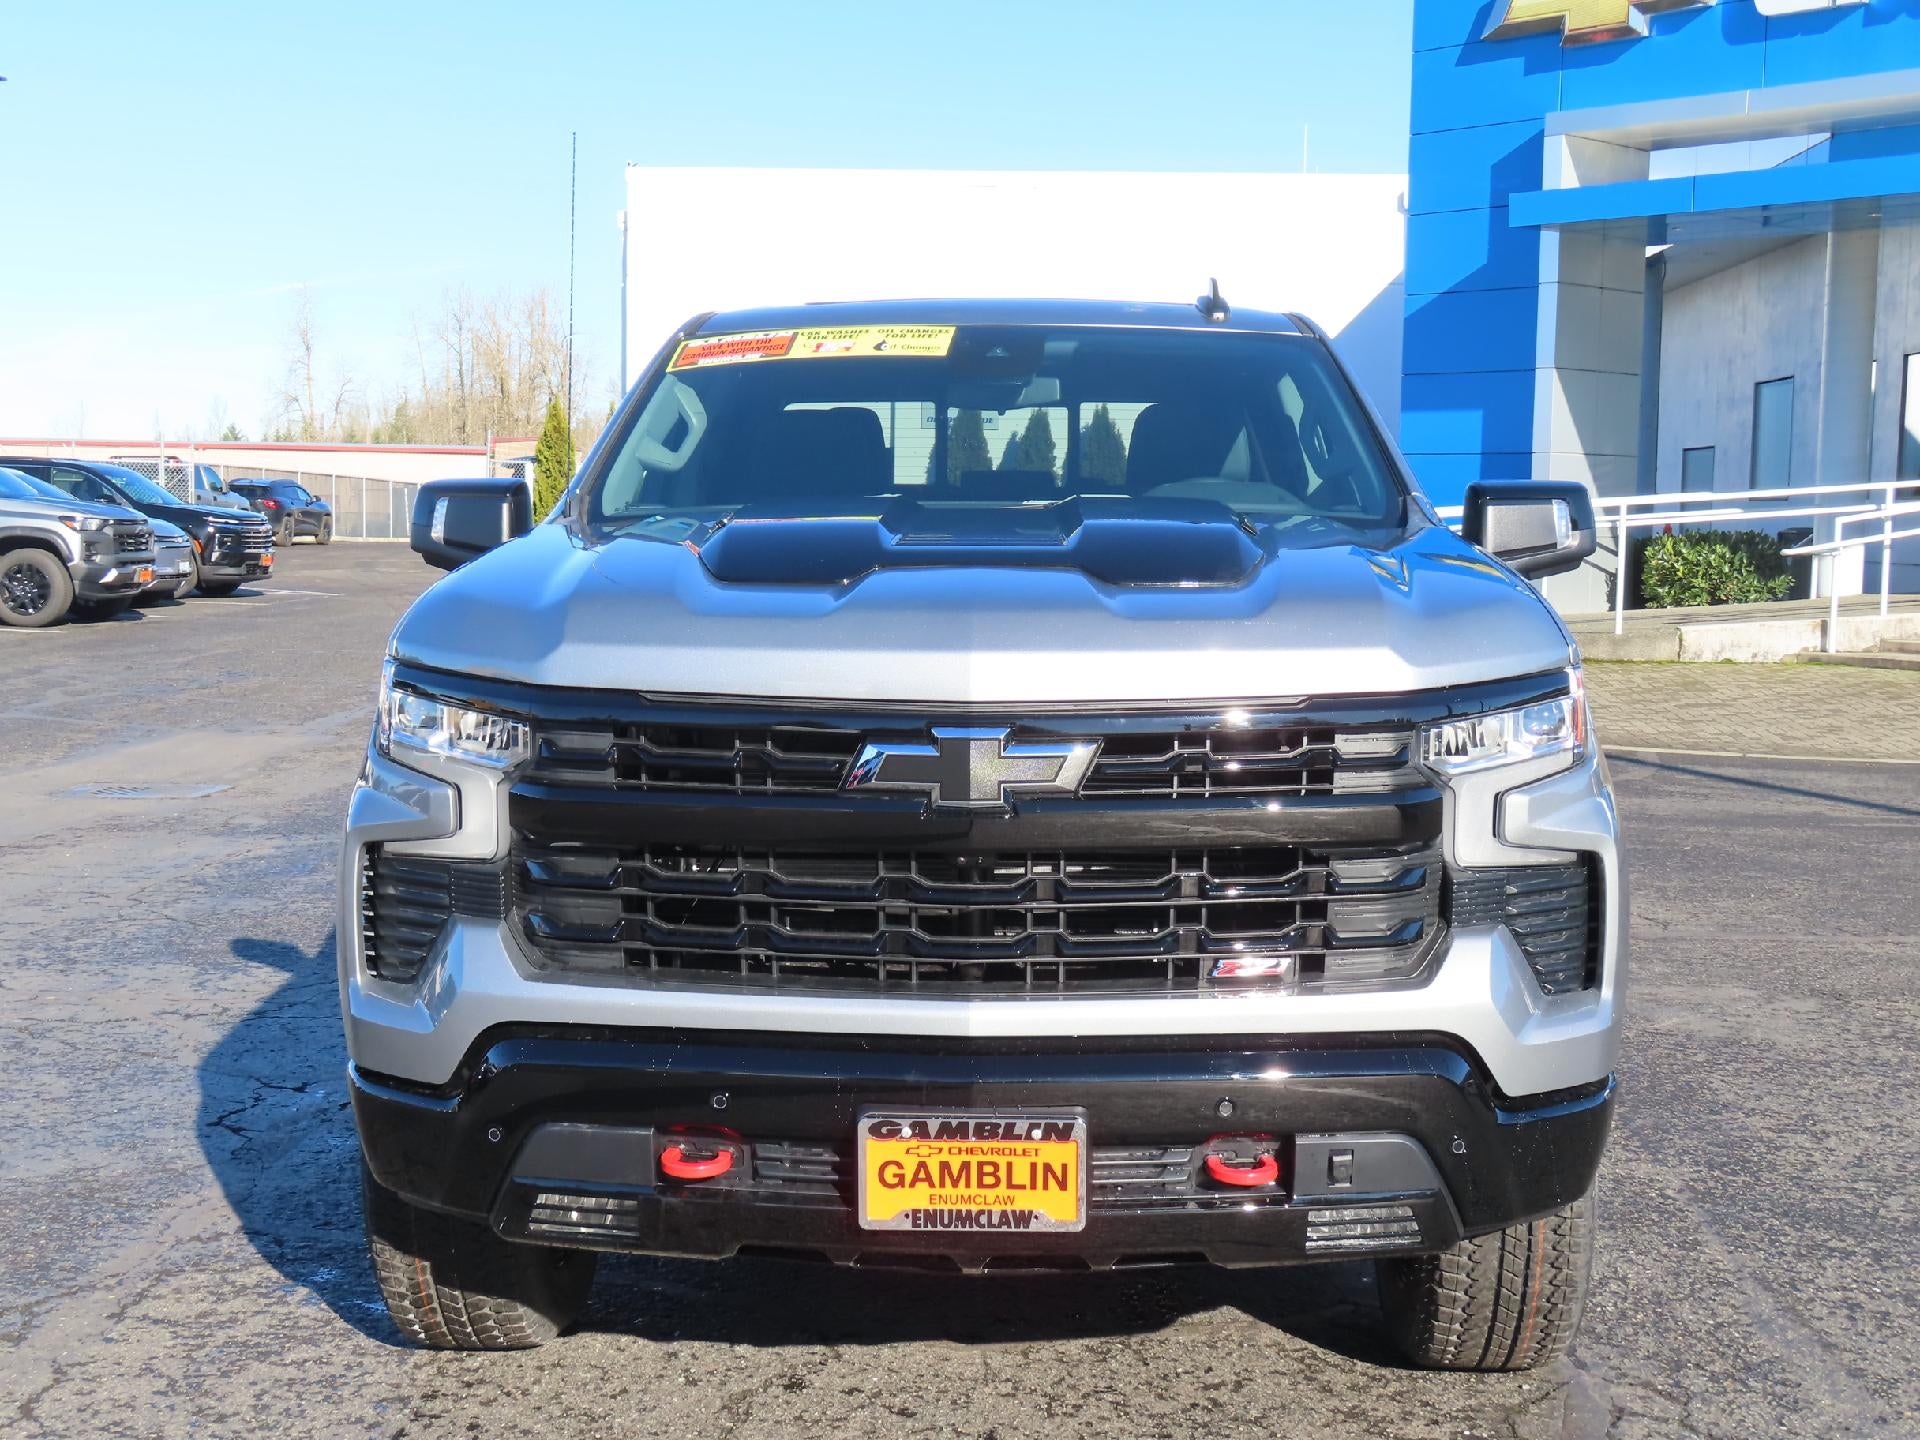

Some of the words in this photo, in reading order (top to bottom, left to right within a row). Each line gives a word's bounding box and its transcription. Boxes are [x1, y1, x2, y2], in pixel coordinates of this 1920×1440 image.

[682, 351, 727, 360] GAMBLIN
[728, 343, 788, 355] ADVANTAGE
[702, 343, 724, 352] SAVE
[726, 340, 753, 349] WITH
[755, 338, 773, 346] THE
[867, 1119, 1077, 1142] GAMBLIN
[947, 1146, 1042, 1158] CHEVROLET
[877, 1160, 1068, 1192] GAMBLIN
[929, 1193, 1016, 1206] ENUMCLAW
[911, 1209, 1034, 1230] ENUMCLAW
